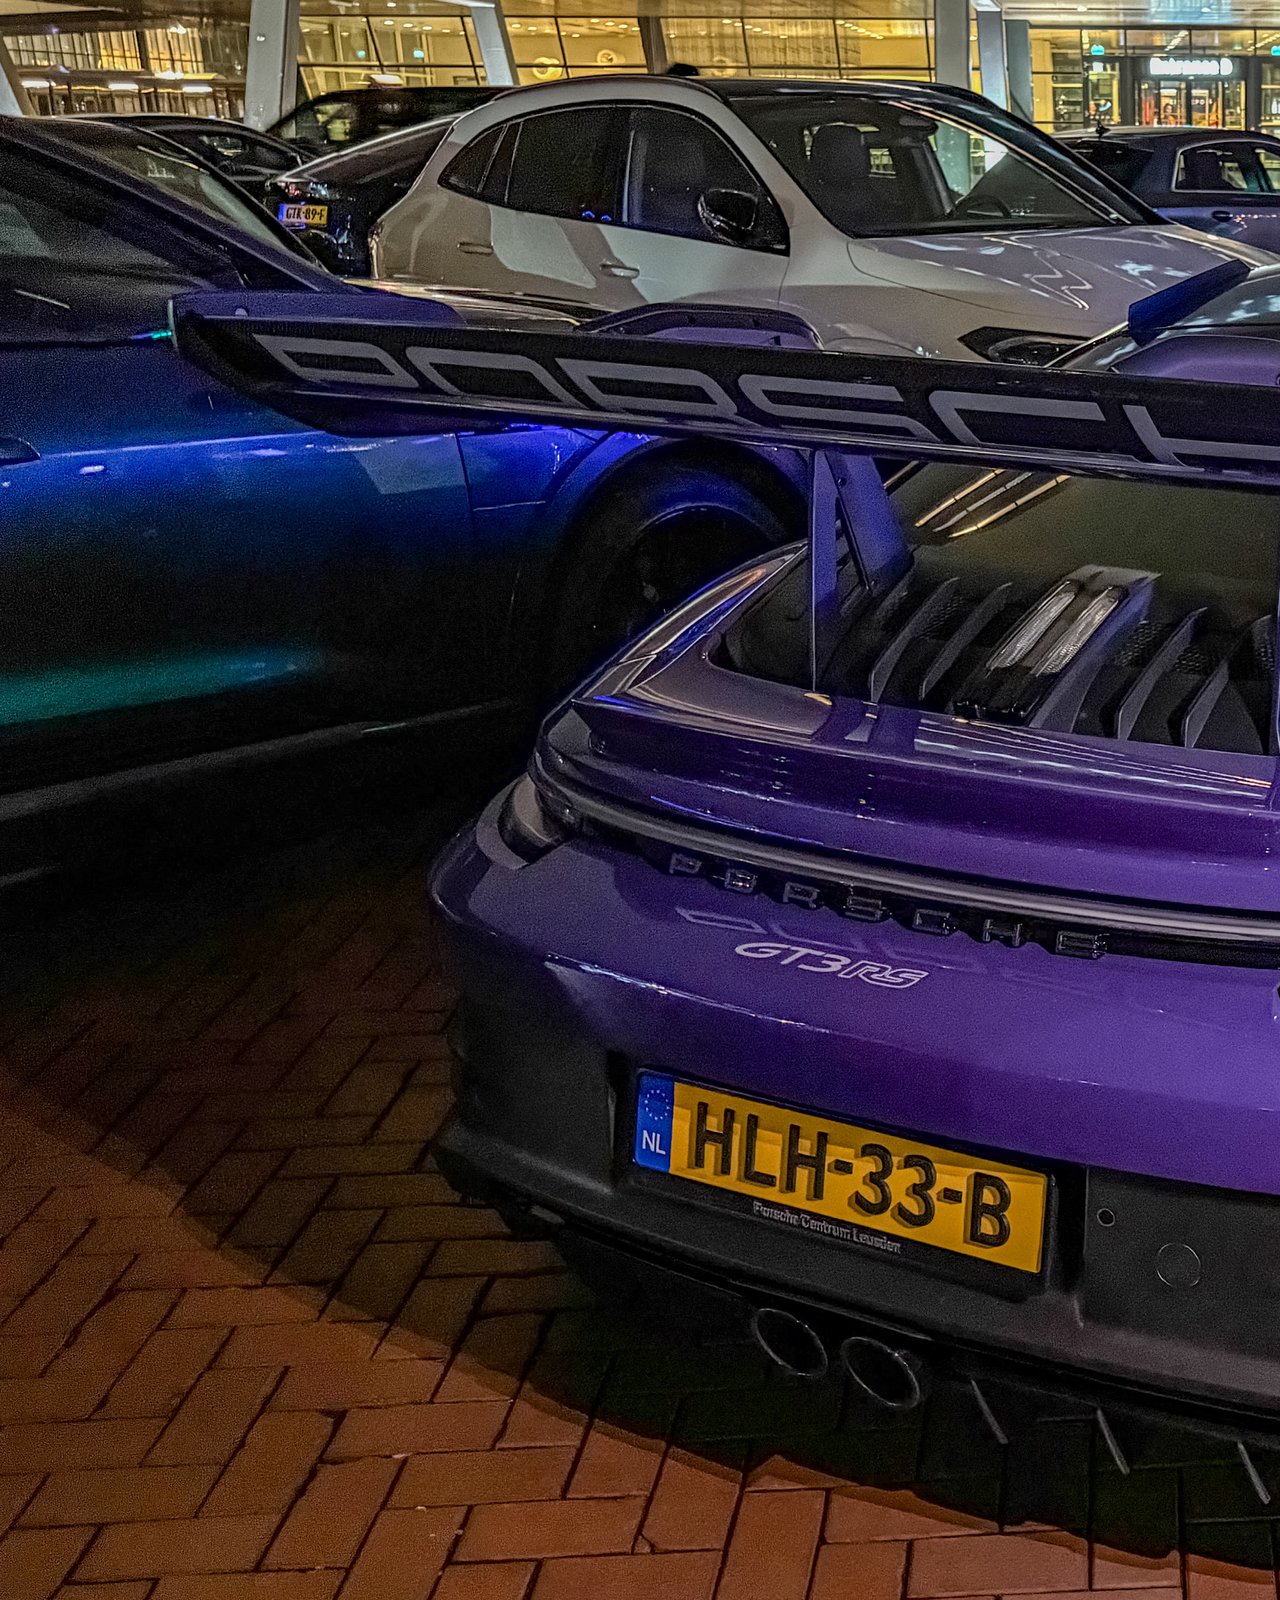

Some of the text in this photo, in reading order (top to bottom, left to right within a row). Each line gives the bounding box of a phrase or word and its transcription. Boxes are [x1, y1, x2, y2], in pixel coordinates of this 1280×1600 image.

[1220, 57, 1233, 76] D
[668, 852, 1105, 961] PORSCHE
[642, 1129, 666, 1156] NL
[694, 1101, 1012, 1249] HLH-33-B
[753, 1200, 901, 1254] Porsche Centrum Leusden
